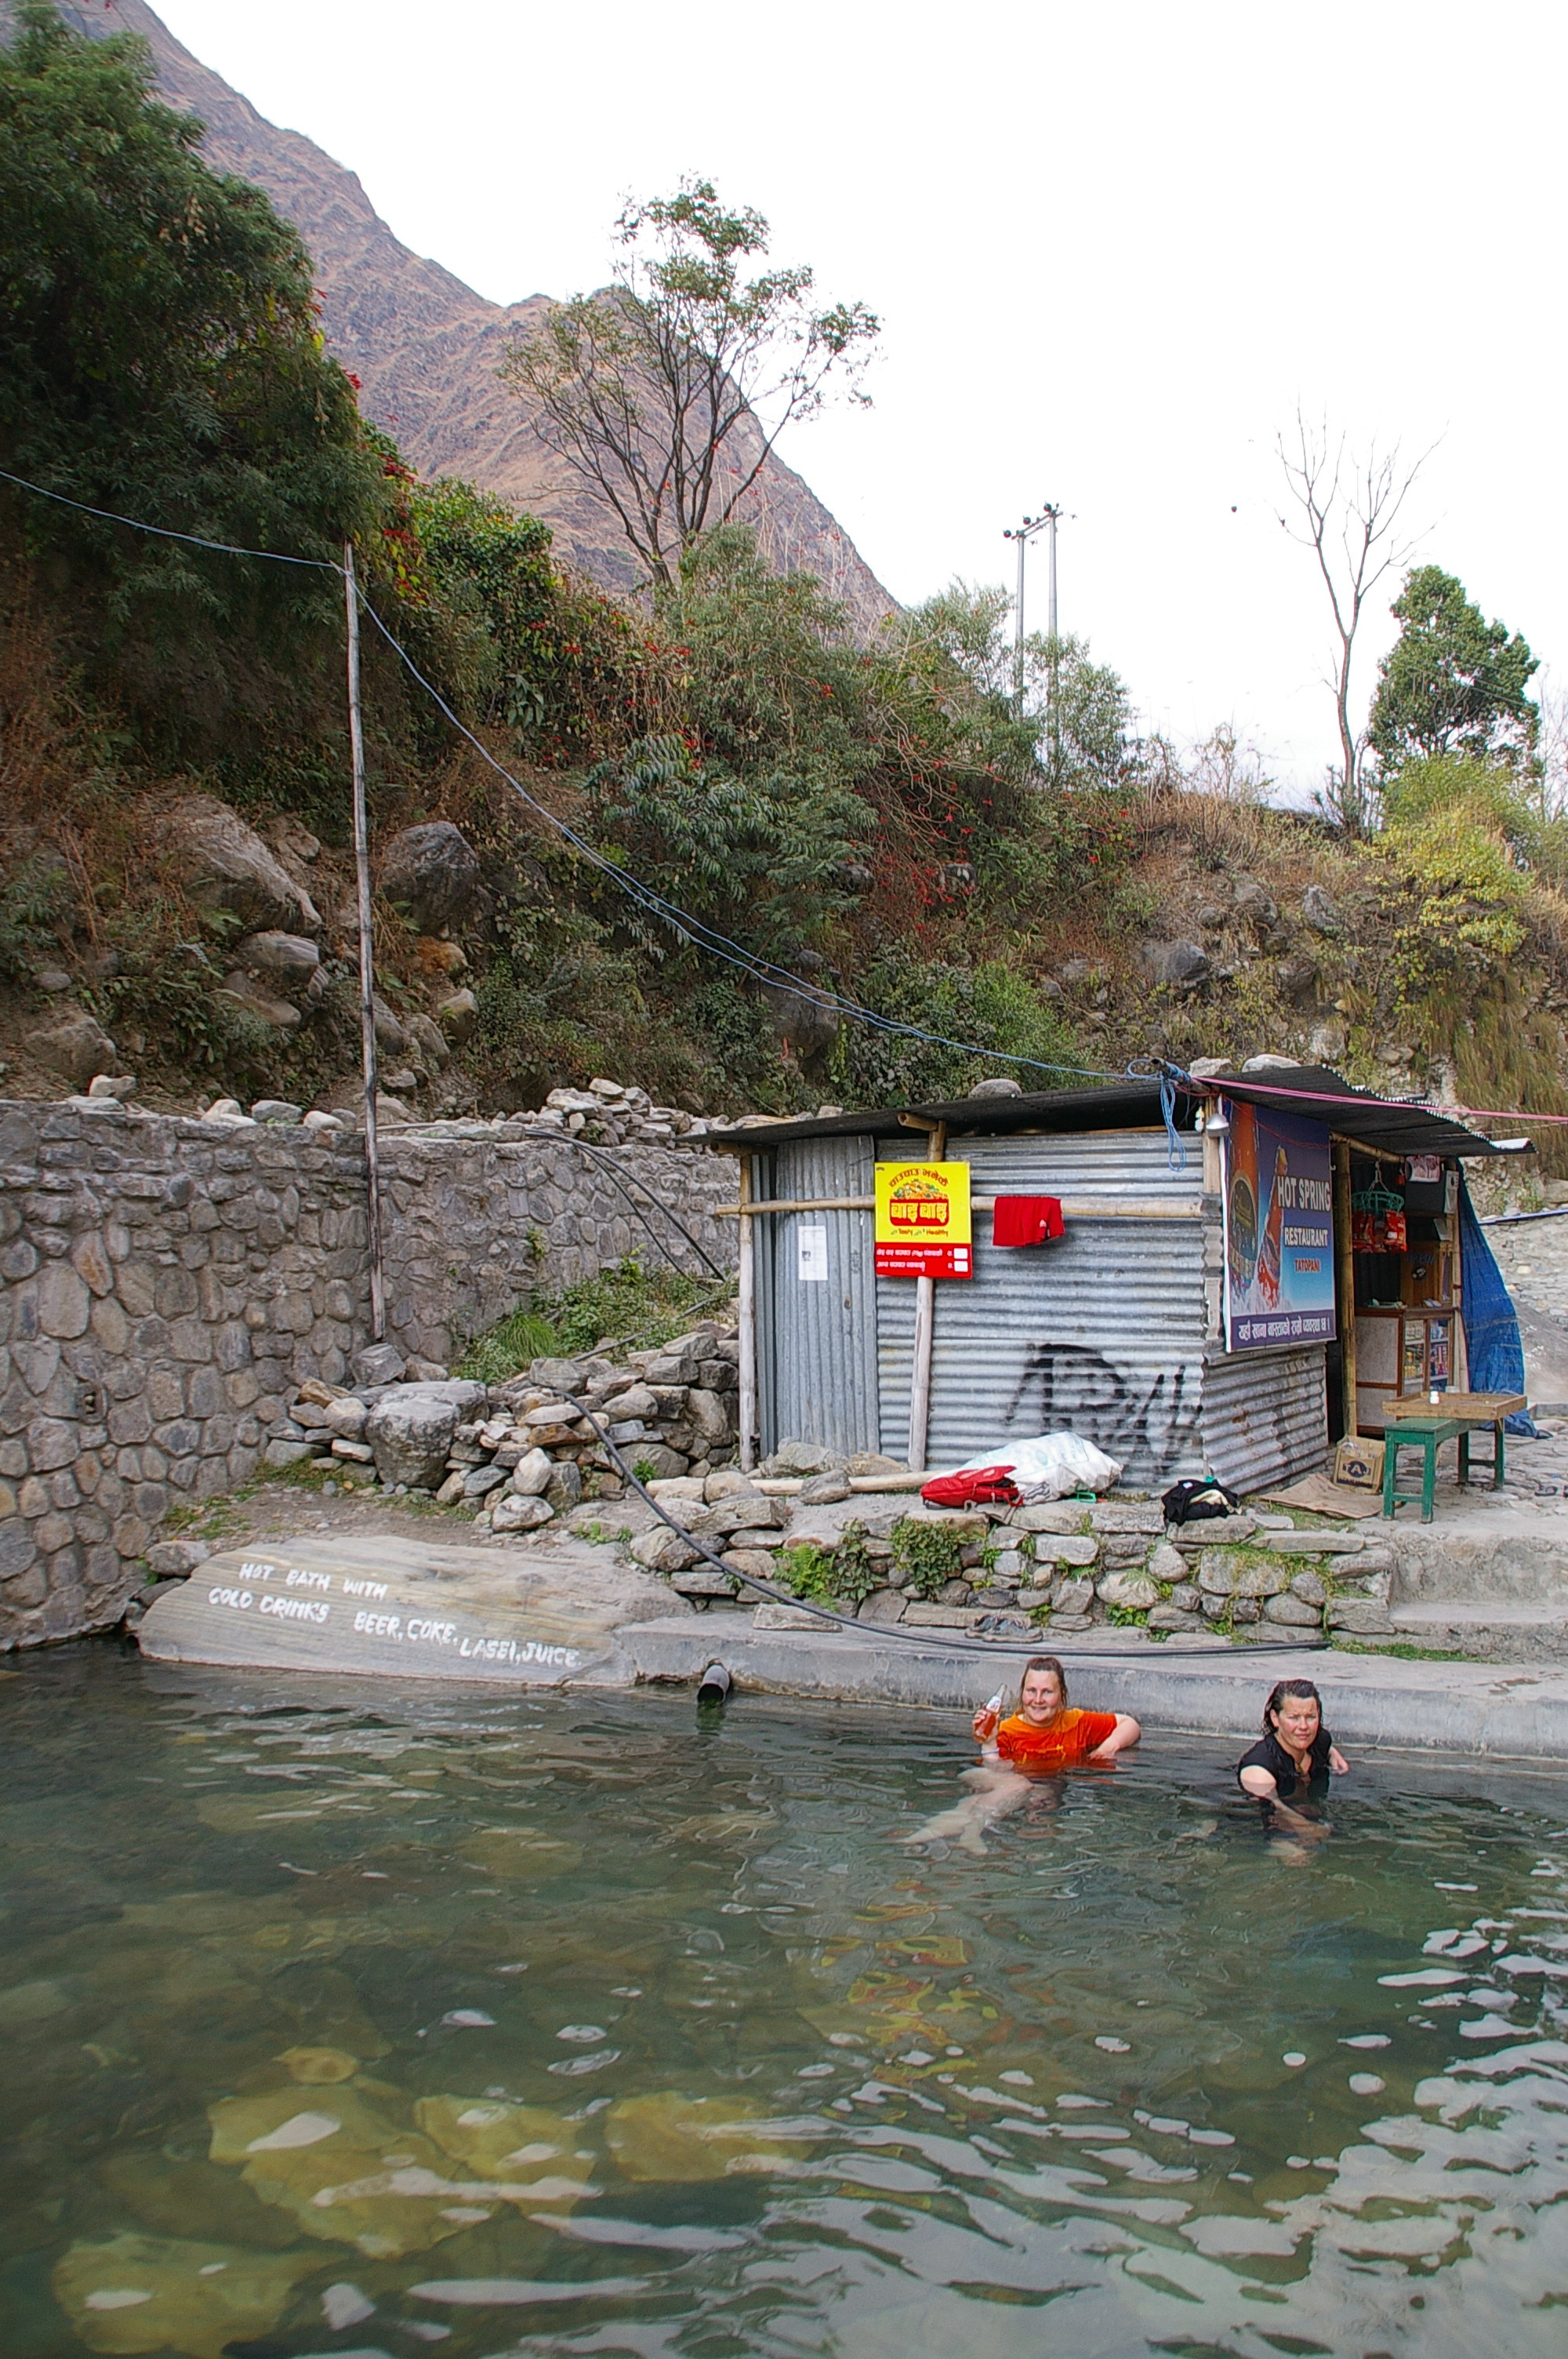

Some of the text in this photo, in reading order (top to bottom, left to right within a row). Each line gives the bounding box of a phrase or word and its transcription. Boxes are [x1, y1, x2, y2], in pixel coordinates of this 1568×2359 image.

[1277, 1176, 1331, 1212] HOT SPRING
[1284, 1227, 1328, 1247] RESTAURANT
[1294, 1258, 1321, 1272] TATOPANI
[238, 1563, 388, 1601] HOT BATH WITH
[209, 1587, 330, 1623] COLD DRINKS
